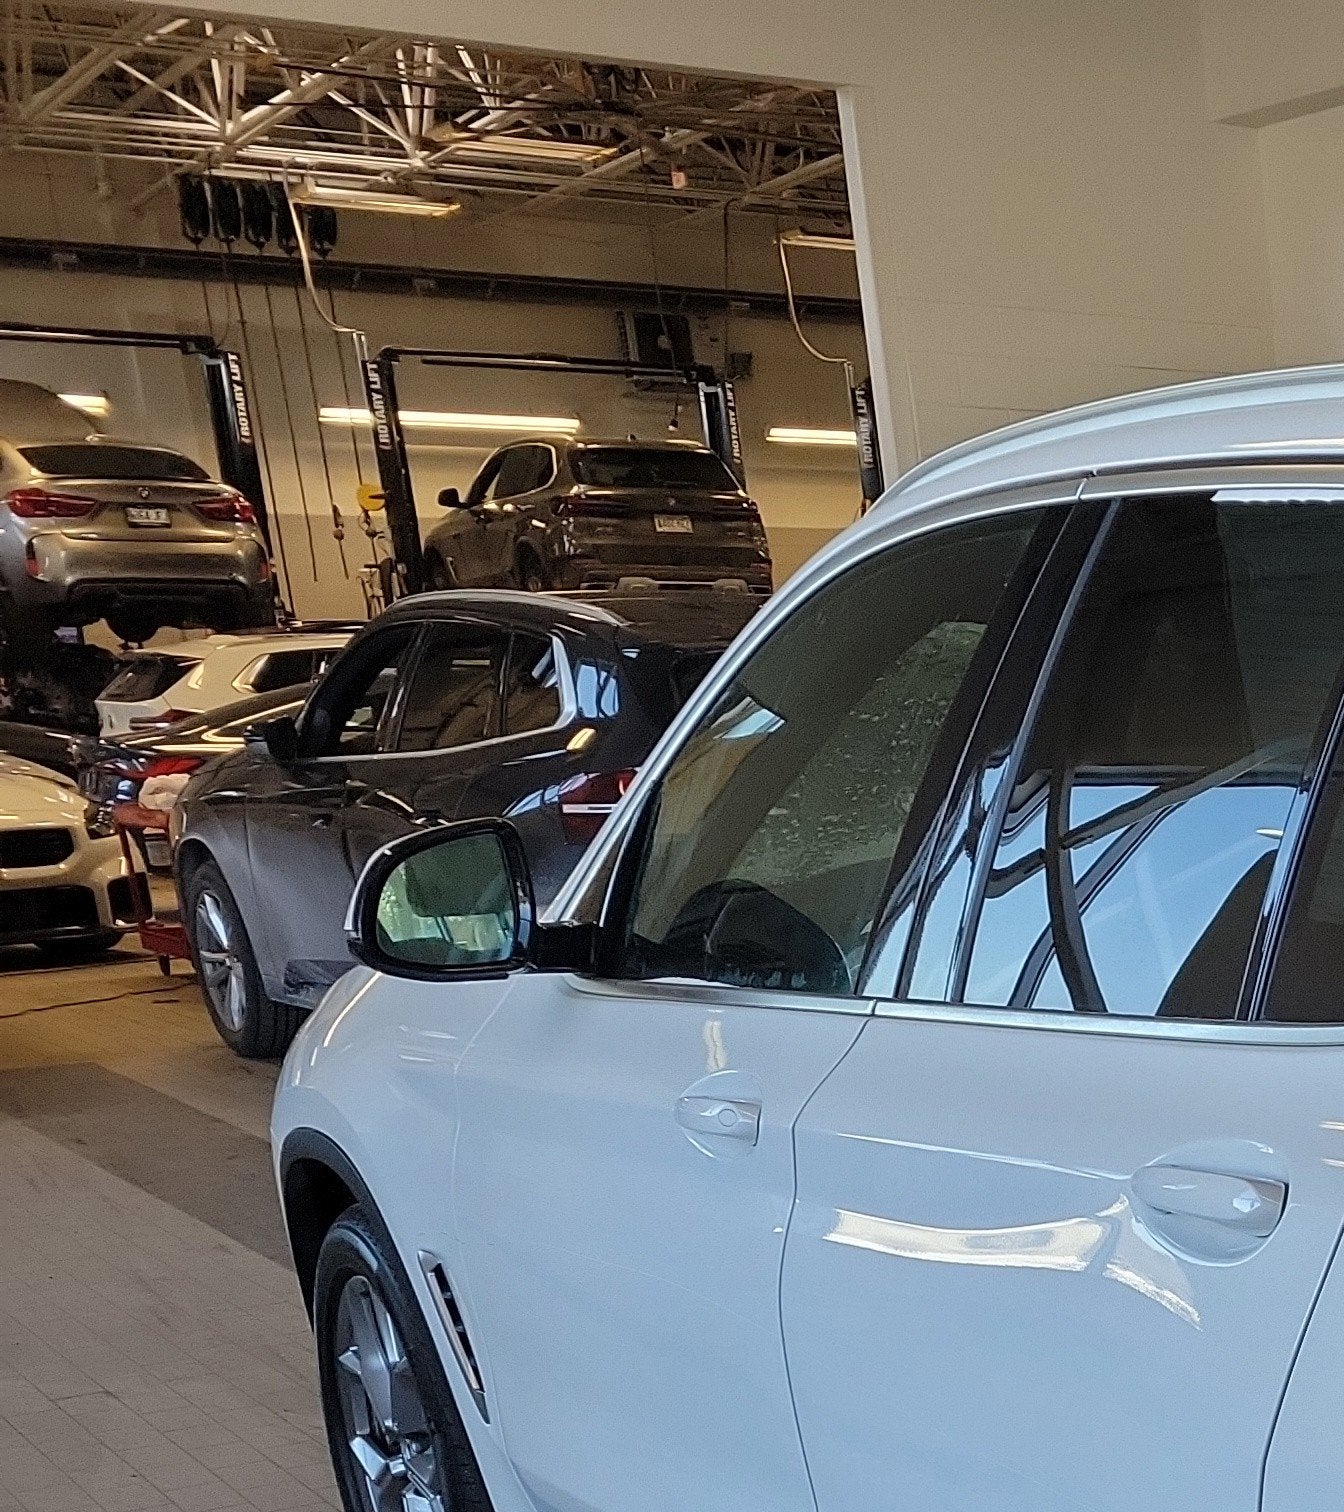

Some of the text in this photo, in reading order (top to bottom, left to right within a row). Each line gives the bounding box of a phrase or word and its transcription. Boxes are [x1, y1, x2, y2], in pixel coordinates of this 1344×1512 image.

[227, 352, 252, 437] ROTARY LIFT
[366, 362, 391, 444] ROTARY LIFT
[724, 381, 736, 407] LIFT
[855, 388, 868, 413] LIFT
